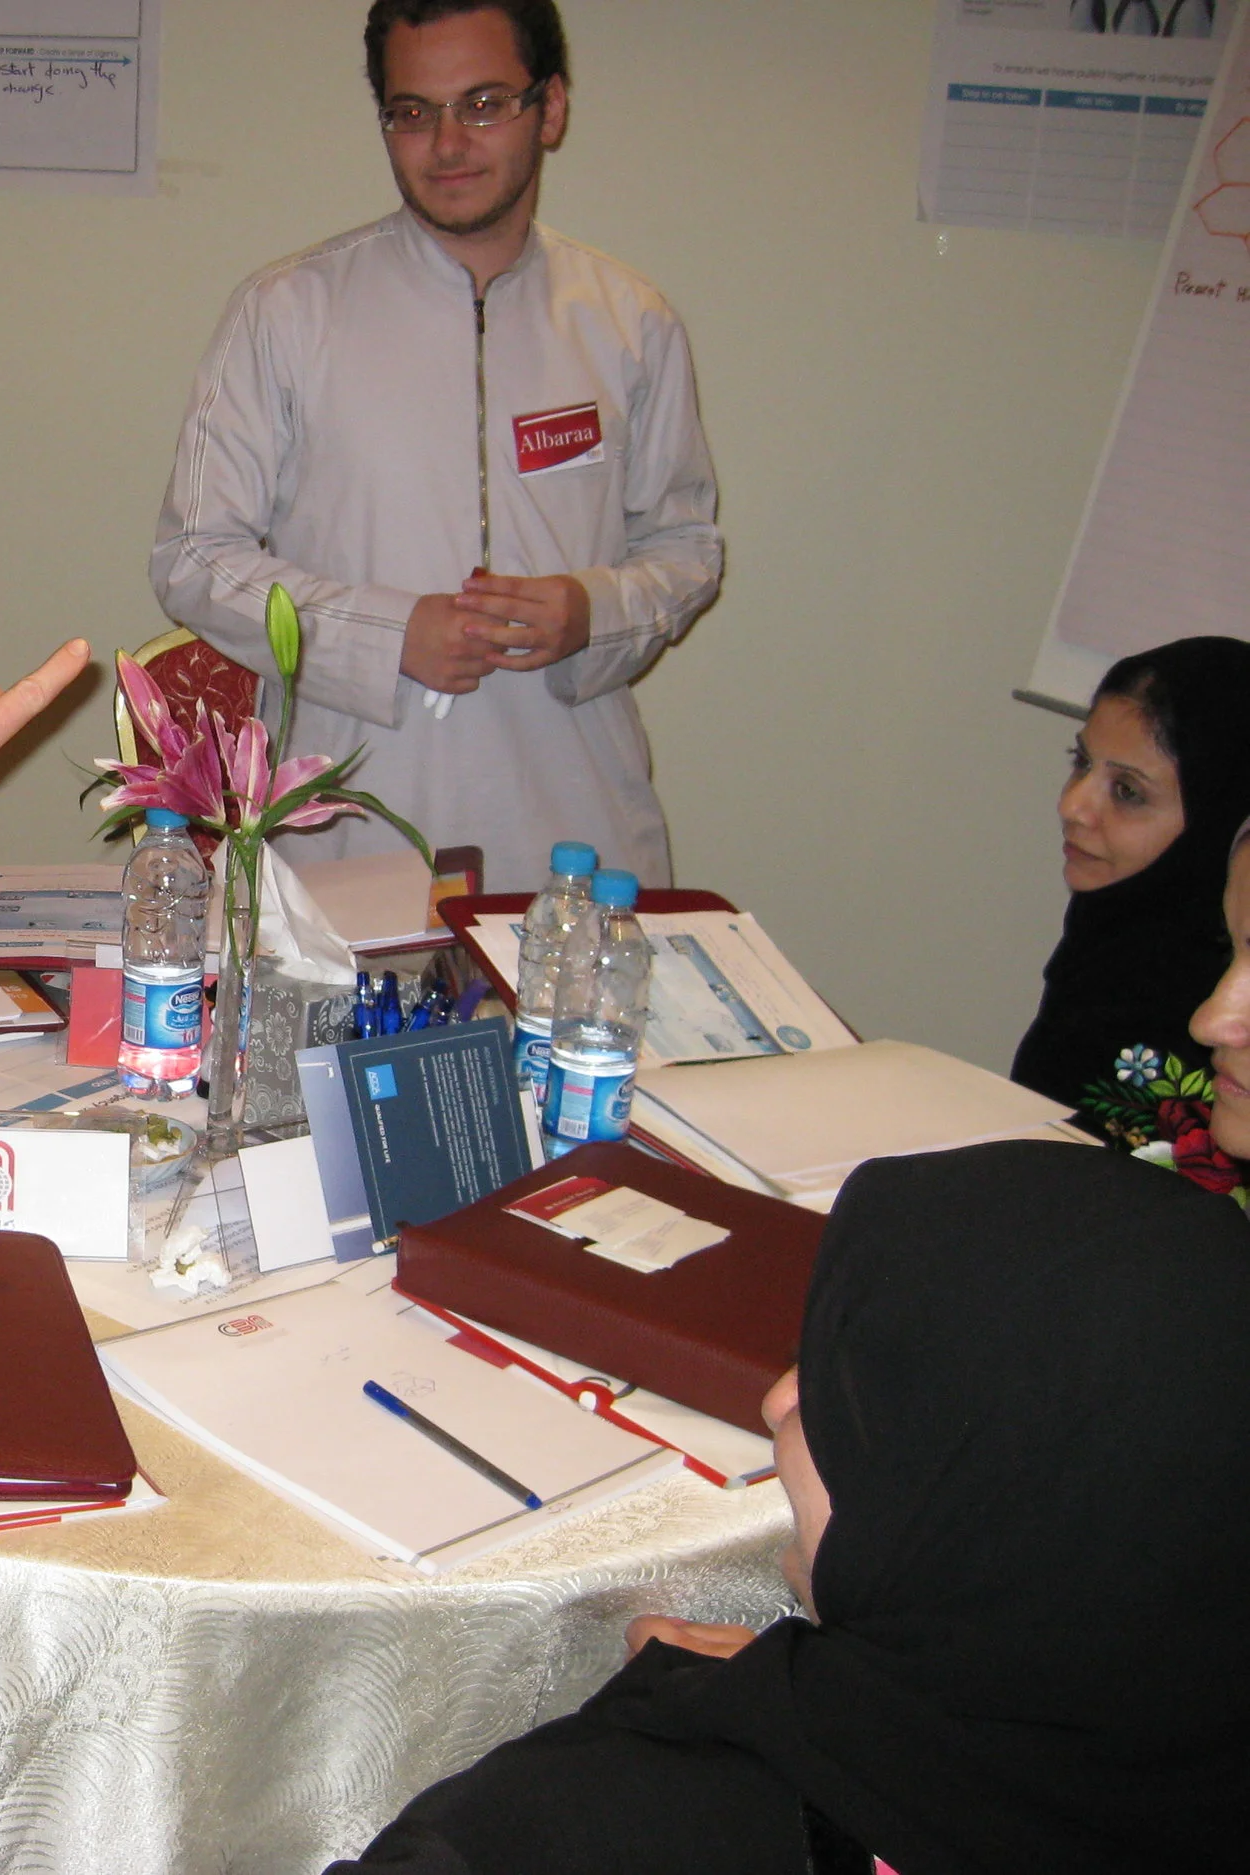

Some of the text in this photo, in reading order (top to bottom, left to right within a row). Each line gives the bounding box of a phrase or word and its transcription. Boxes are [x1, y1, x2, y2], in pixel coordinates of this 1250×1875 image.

[44, 61, 88, 89] doing
[89, 60, 117, 89] the
[520, 426, 594, 453] Albaraa
